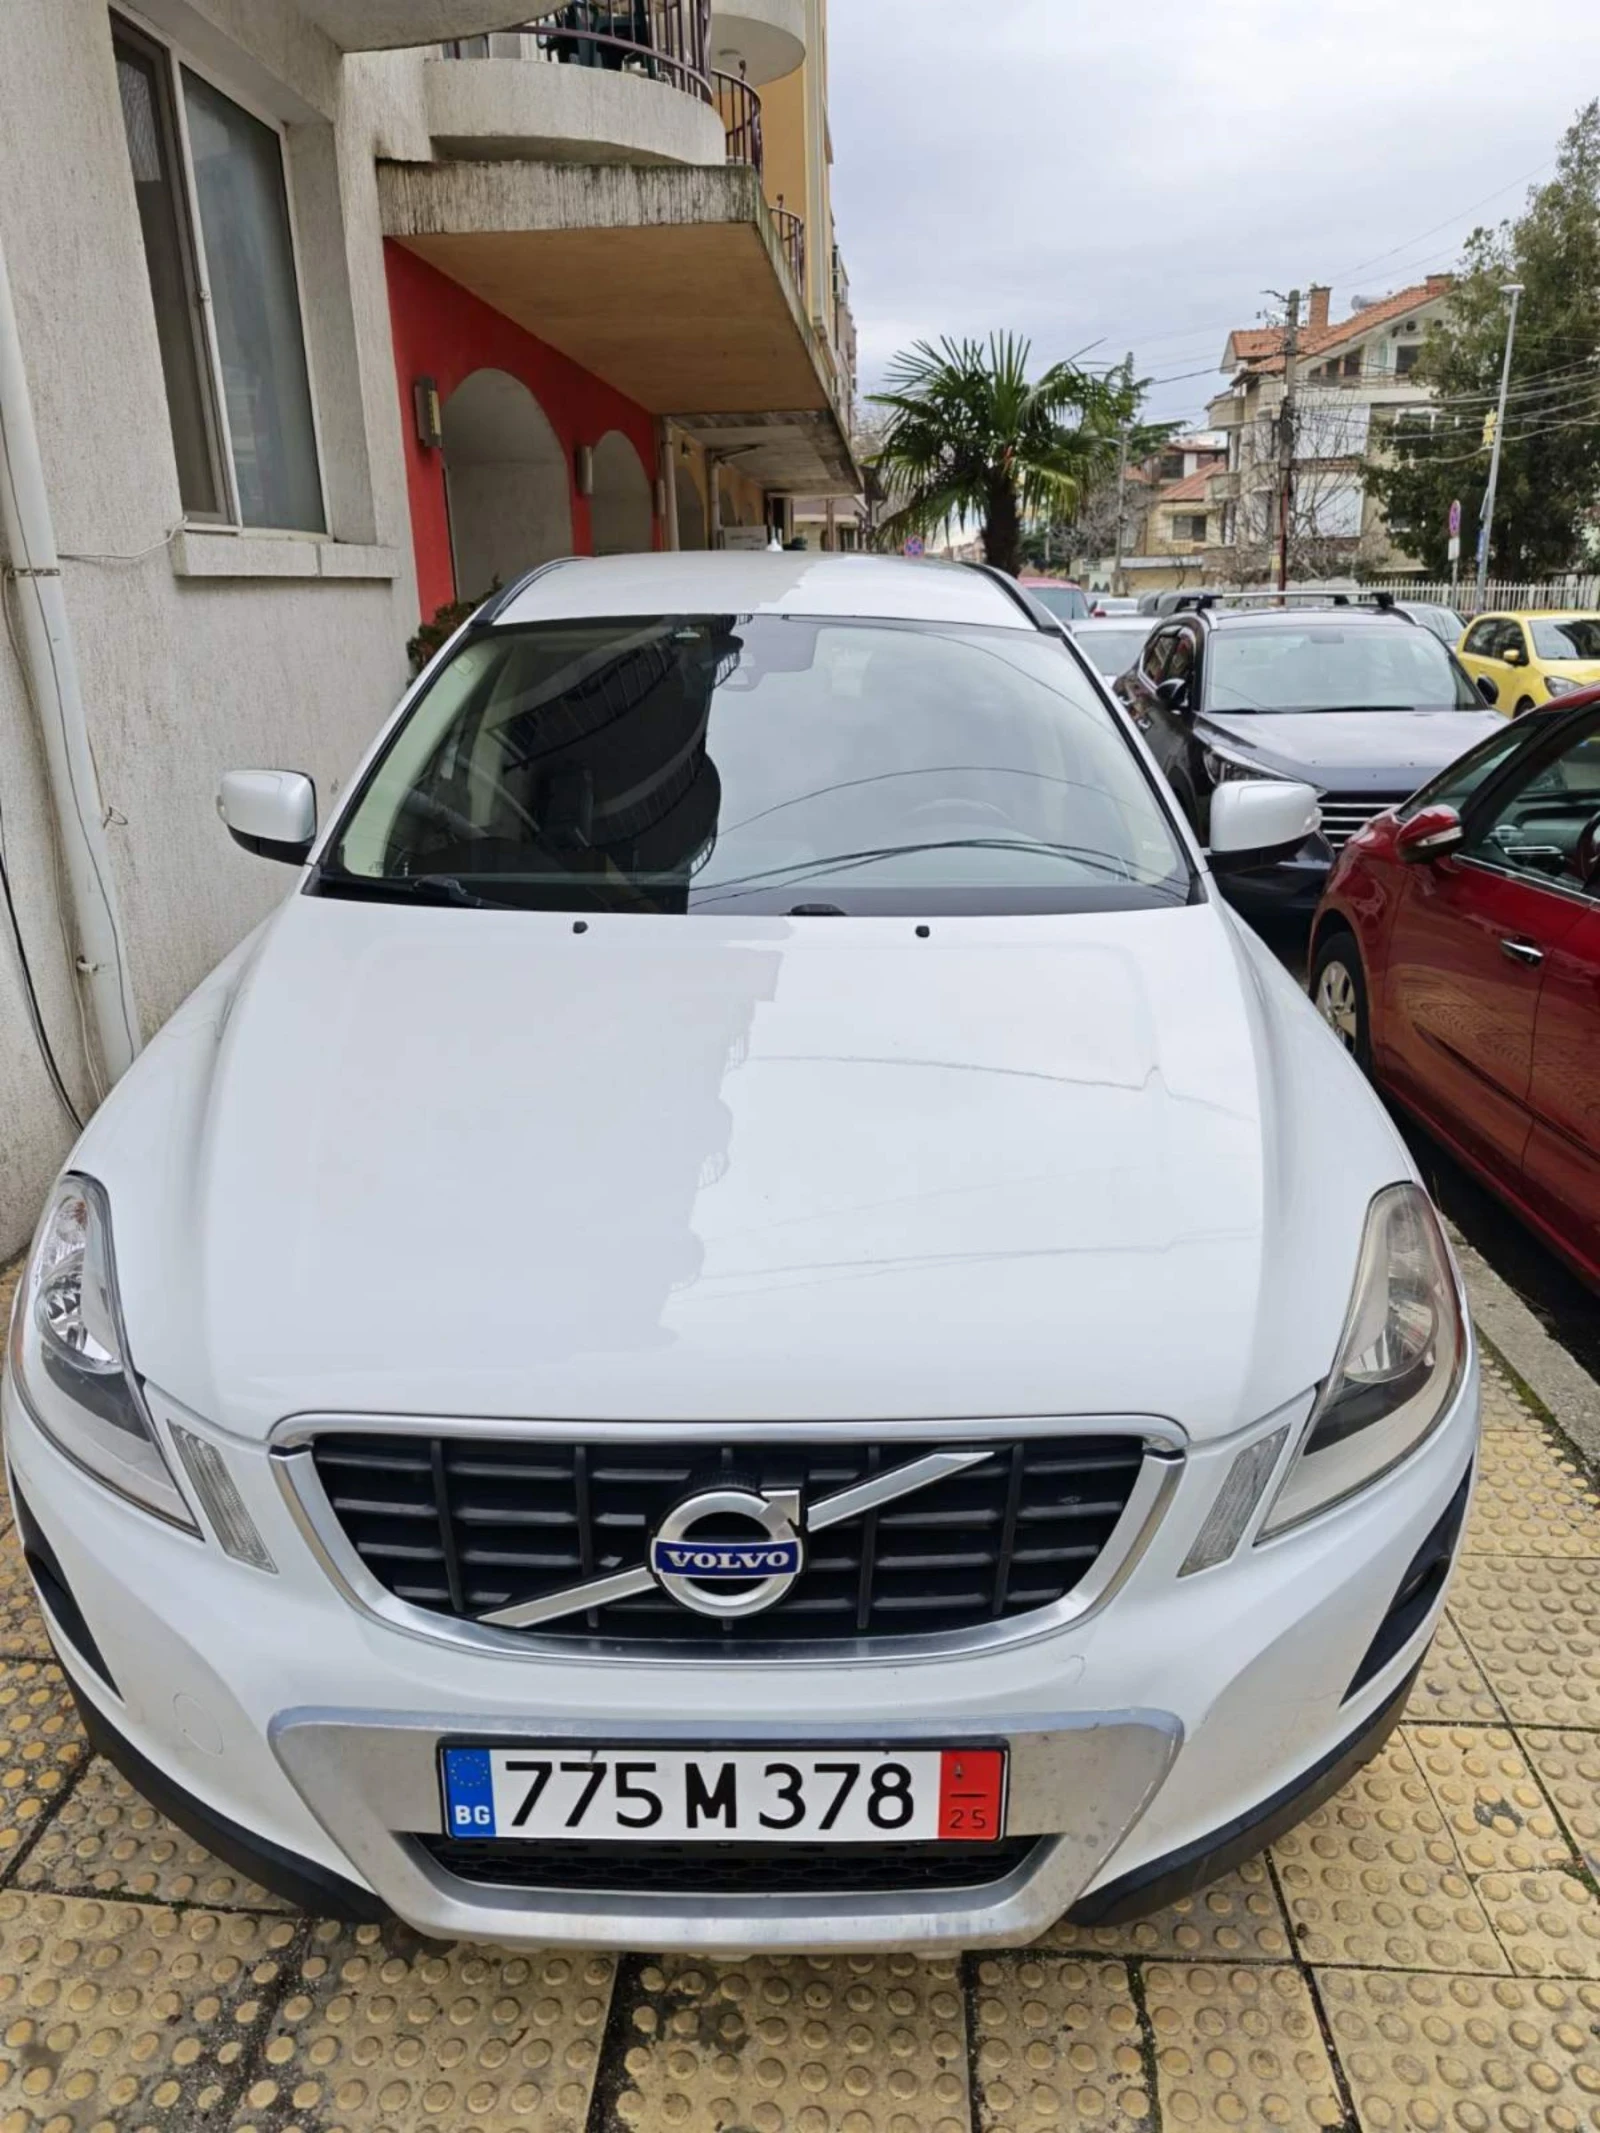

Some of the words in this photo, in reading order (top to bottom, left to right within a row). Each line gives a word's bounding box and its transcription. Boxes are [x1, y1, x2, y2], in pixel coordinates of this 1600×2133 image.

[665, 1551, 790, 1569] VOLVO
[506, 1761, 663, 1829] 775
[685, 1762, 737, 1828] M
[759, 1762, 914, 1830] 378
[455, 1805, 491, 1825] BG
[949, 1808, 986, 1829] 25
